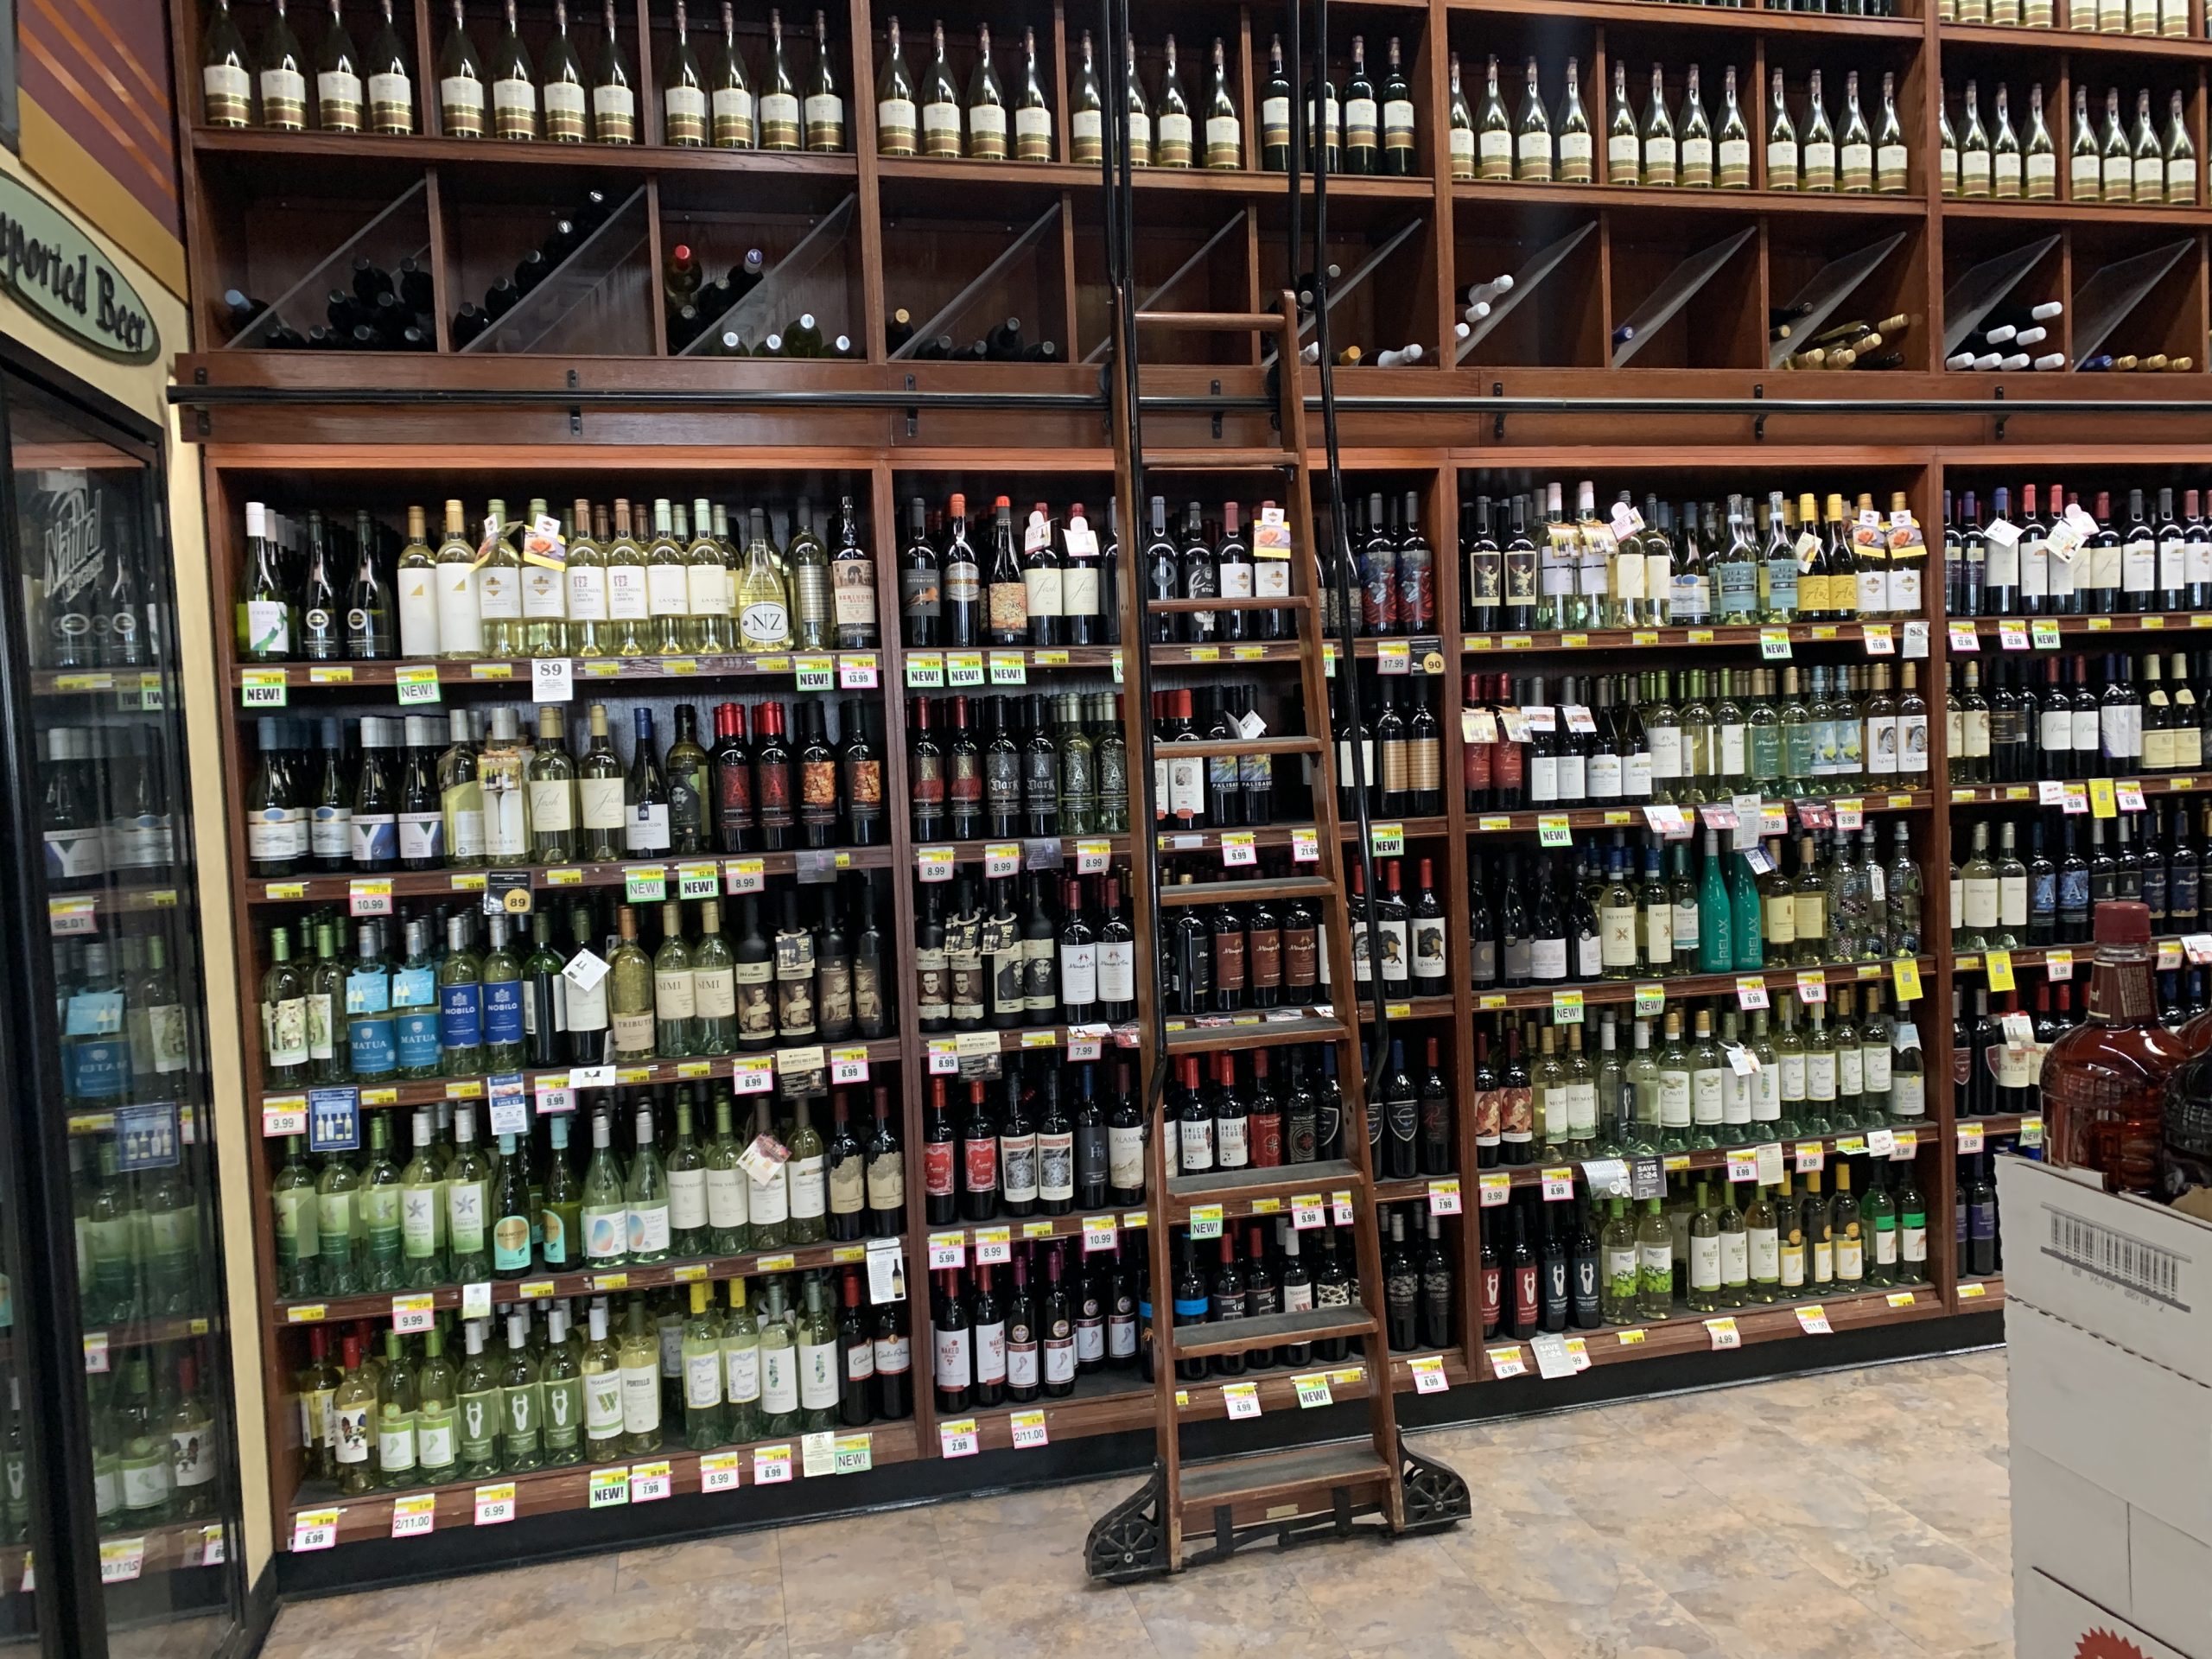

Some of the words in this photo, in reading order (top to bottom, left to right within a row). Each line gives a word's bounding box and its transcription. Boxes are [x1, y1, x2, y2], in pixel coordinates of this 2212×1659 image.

[0, 212, 87, 315] ported
[95, 265, 145, 353] Beer
[751, 613, 782, 631] NZ
[1910, 626, 1923, 637] 88
[2037, 634, 2057, 644] NEW!
[1765, 644, 1788, 654] NEW!
[1383, 658, 1404, 668] 17.99
[1427, 660, 1441, 669] 90
[540, 664, 562, 676] 89
[994, 668, 1021, 680] NEW!
[800, 673, 828, 685] NEW!
[849, 674, 868, 683] 13.99
[911, 671, 939, 682] NEW!
[950, 670, 979, 681] NEW!
[247, 688, 280, 701] NEW!
[401, 683, 433, 698] NEW!
[1764, 820, 1779, 829] 7.99
[1543, 830, 1567, 841] NEW!
[1376, 841, 1400, 851] NEW!
[1231, 851, 1246, 861] 9.99
[994, 862, 1010, 872] 8.99
[1085, 858, 1102, 868] 8.99
[927, 867, 944, 875] 8.99
[630, 882, 659, 893] NEW!
[684, 881, 713, 893] NEW!
[735, 879, 753, 887] 8.99
[357, 899, 383, 909] 10.99
[510, 898, 525, 906] 89
[1719, 918, 1728, 958] RELAX
[658, 982, 681, 990] SIMI
[1747, 995, 1760, 1004] 9.99
[445, 1007, 475, 1015] NOBILO
[1638, 1001, 1661, 1011] NEW!
[1557, 1008, 1579, 1019] NEW!
[401, 1033, 436, 1044] MATUA
[352, 1040, 386, 1049] MATUA
[842, 1067, 858, 1077] 8.99
[745, 1077, 761, 1087] 8.99
[546, 1096, 564, 1106] 9.99
[273, 1118, 294, 1128] 9.99
[1551, 1186, 1565, 1195] 8.99
[1488, 1192, 1502, 1201] 9.99
[1193, 1223, 1217, 1234] NEW!
[1090, 1235, 1111, 1244] 10.99
[983, 1247, 1001, 1256] 8.99
[939, 1254, 955, 1263] 5.99
[403, 1316, 423, 1325] 9.99
[1718, 1335, 1733, 1344] 4.99
[1502, 1364, 1517, 1374] 6.99
[1302, 1390, 1327, 1402] NEW!
[1236, 1403, 1251, 1412] 4.99
[1014, 1428, 1044, 1441] 2/11.00
[952, 1441, 968, 1451] 2.99
[838, 1454, 866, 1467] NEW!
[765, 1468, 781, 1478] 8.99
[710, 1474, 728, 1484] 8.99
[594, 1487, 624, 1501] NEW!
[643, 1484, 658, 1494] 7.99
[485, 1506, 504, 1516] 6.99
[395, 1516, 429, 1529] 2/11.00
[305, 1534, 323, 1544] 6.99
